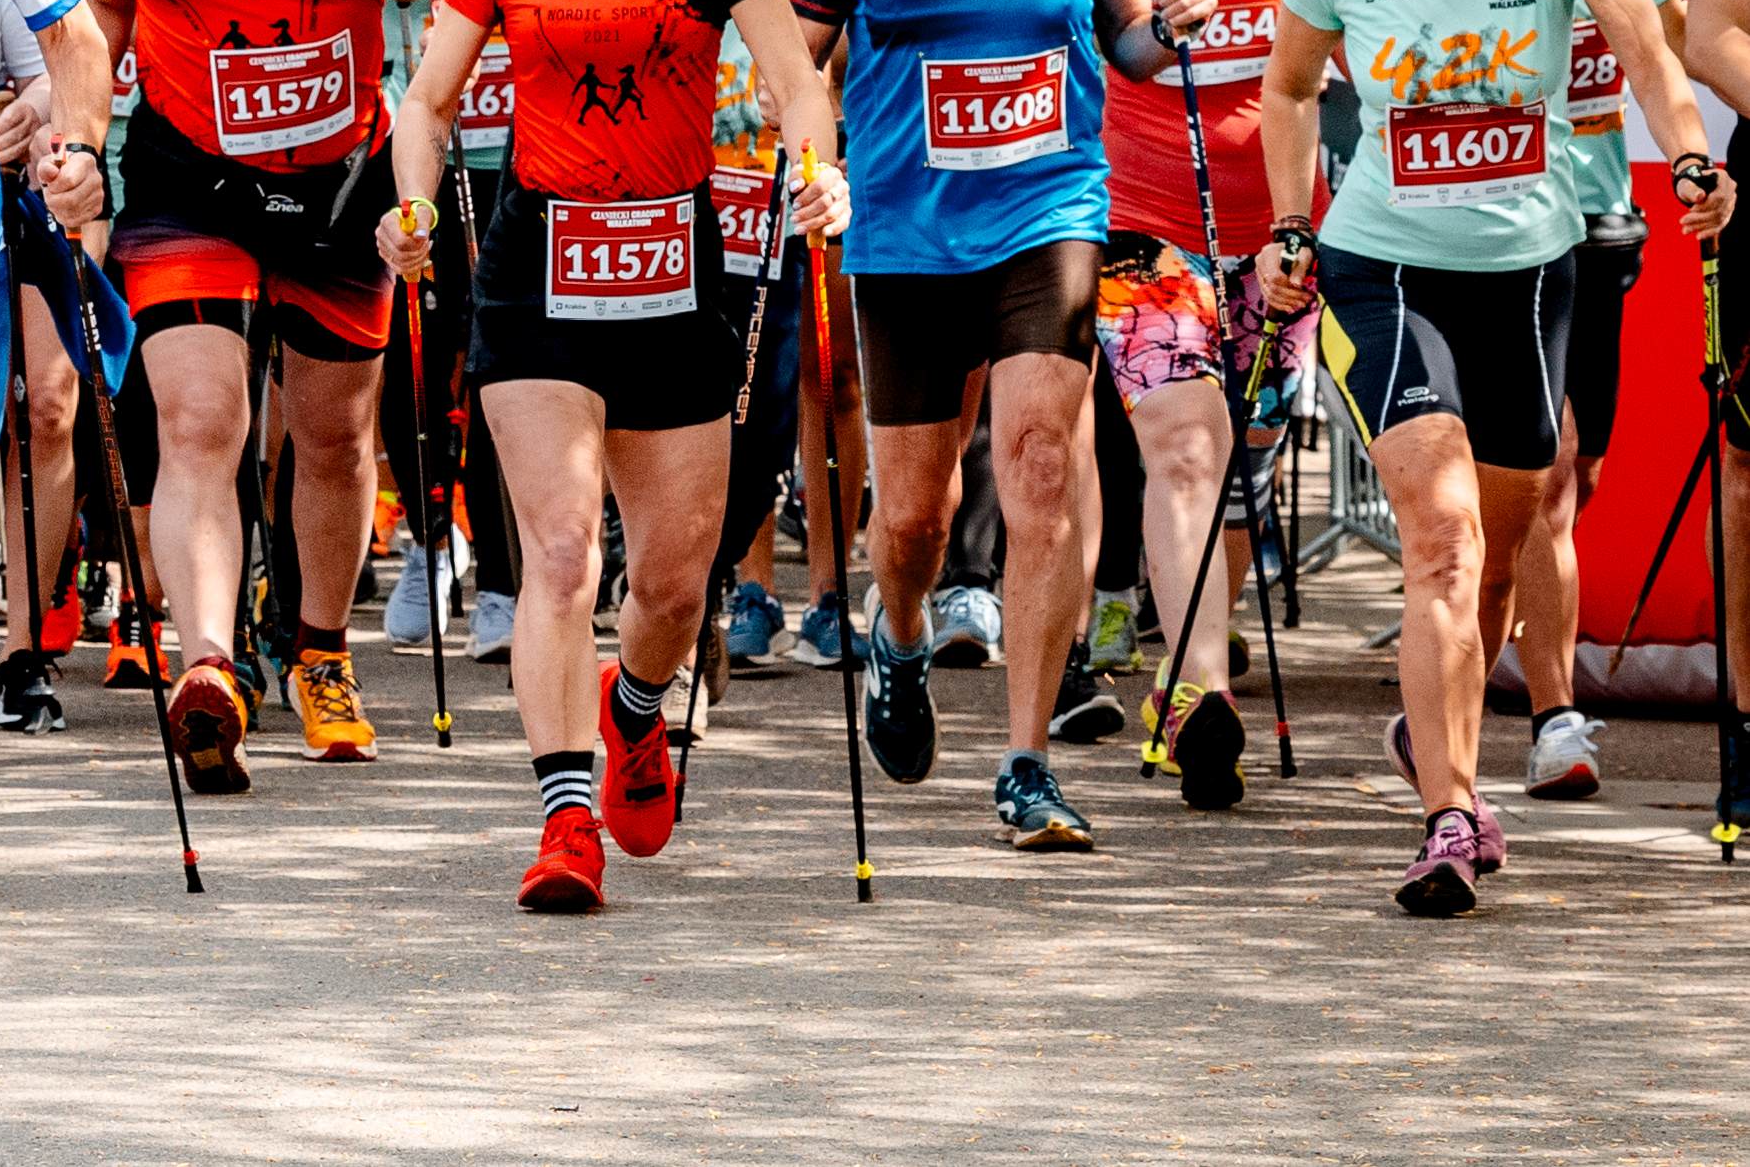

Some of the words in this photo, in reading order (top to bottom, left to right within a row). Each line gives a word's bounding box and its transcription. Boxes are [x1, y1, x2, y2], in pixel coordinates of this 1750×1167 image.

[548, 8, 602, 22] NORDIC
[611, 6, 656, 21] SPORT
[584, 30, 620, 43] 2021
[228, 70, 343, 121] 11579
[939, 86, 1054, 134] 11608
[1403, 124, 1534, 170] 11607
[564, 238, 685, 281] 11578
